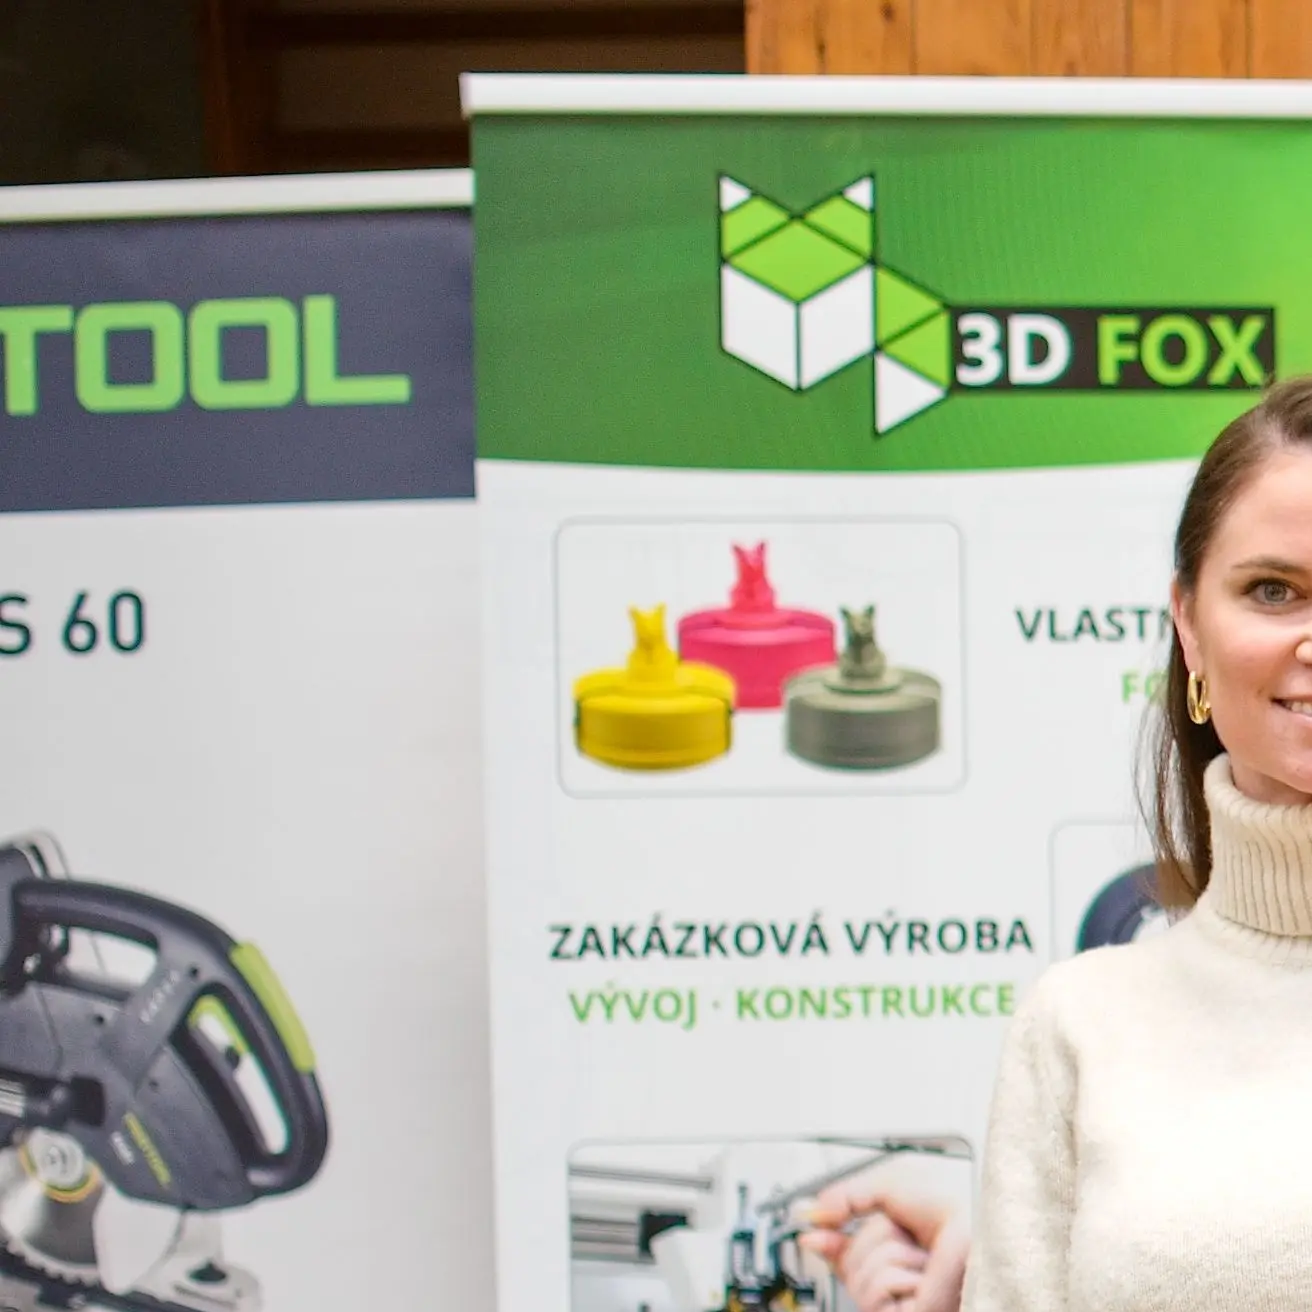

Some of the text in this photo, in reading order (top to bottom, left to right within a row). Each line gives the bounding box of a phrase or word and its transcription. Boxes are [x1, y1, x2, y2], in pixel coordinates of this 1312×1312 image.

[0, 296, 411, 415] TOOL
[956, 312, 1267, 386] 3D FOX
[61, 590, 146, 656] 60
[548, 908, 1034, 960] ZAKÁZKOVÁ VÝROBA
[568, 981, 1016, 1031] VÝVOJ KONSTRUKCE
